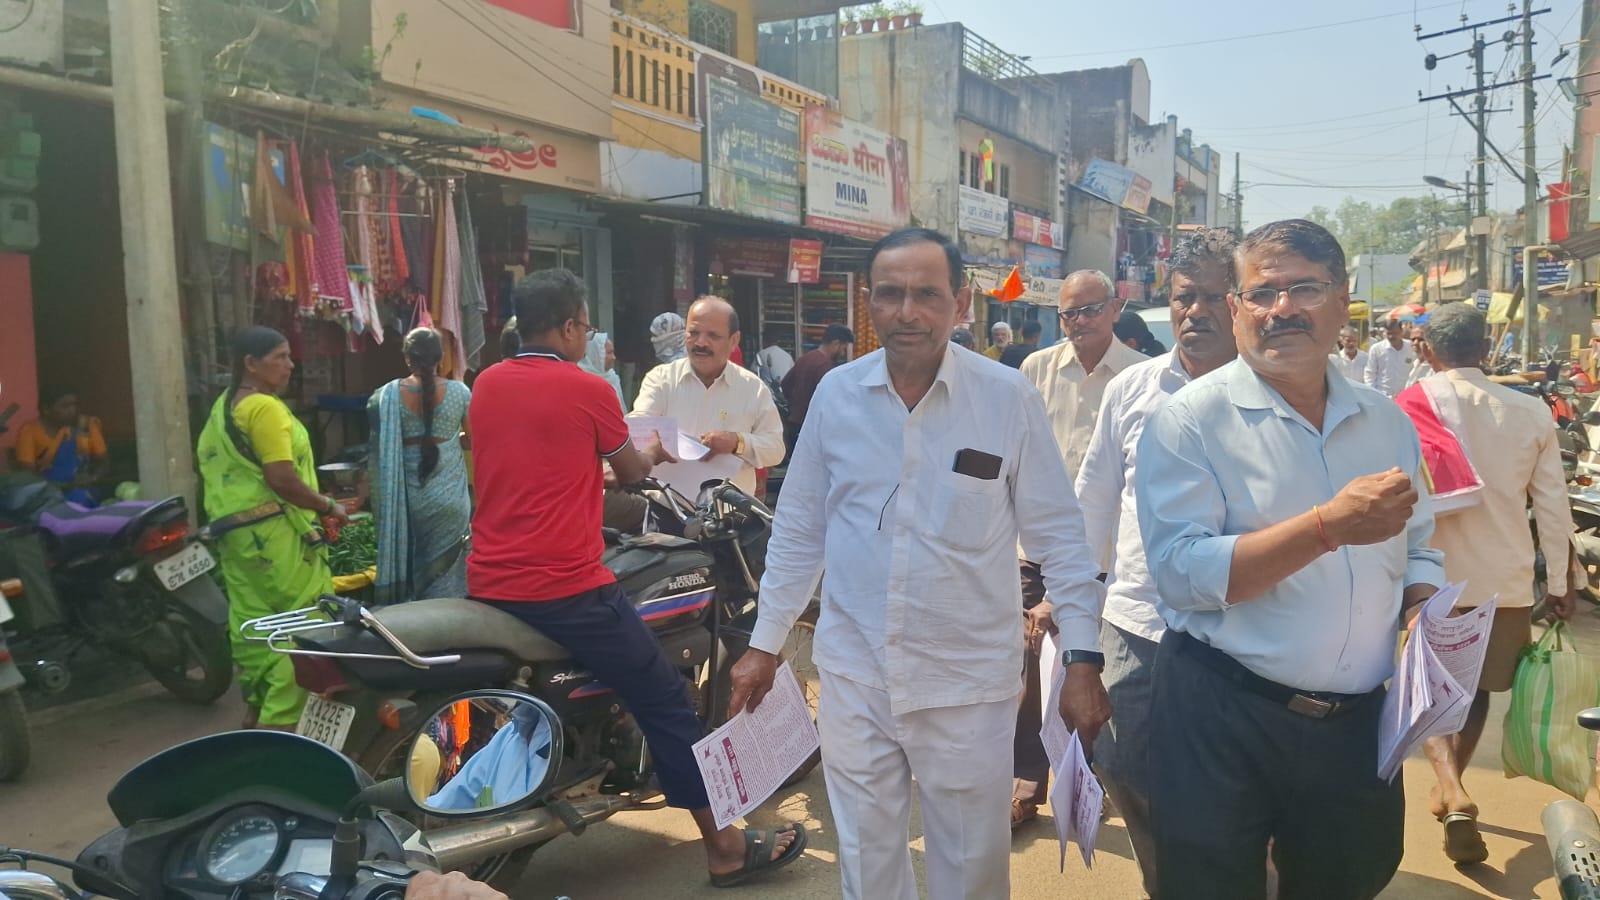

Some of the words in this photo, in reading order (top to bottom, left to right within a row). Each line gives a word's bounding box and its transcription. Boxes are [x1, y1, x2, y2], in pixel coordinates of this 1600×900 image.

[852, 142, 885, 178] मीना
[836, 182, 868, 205] MINA
[668, 577, 706, 590] HONDA
[674, 572, 700, 582] HERO
